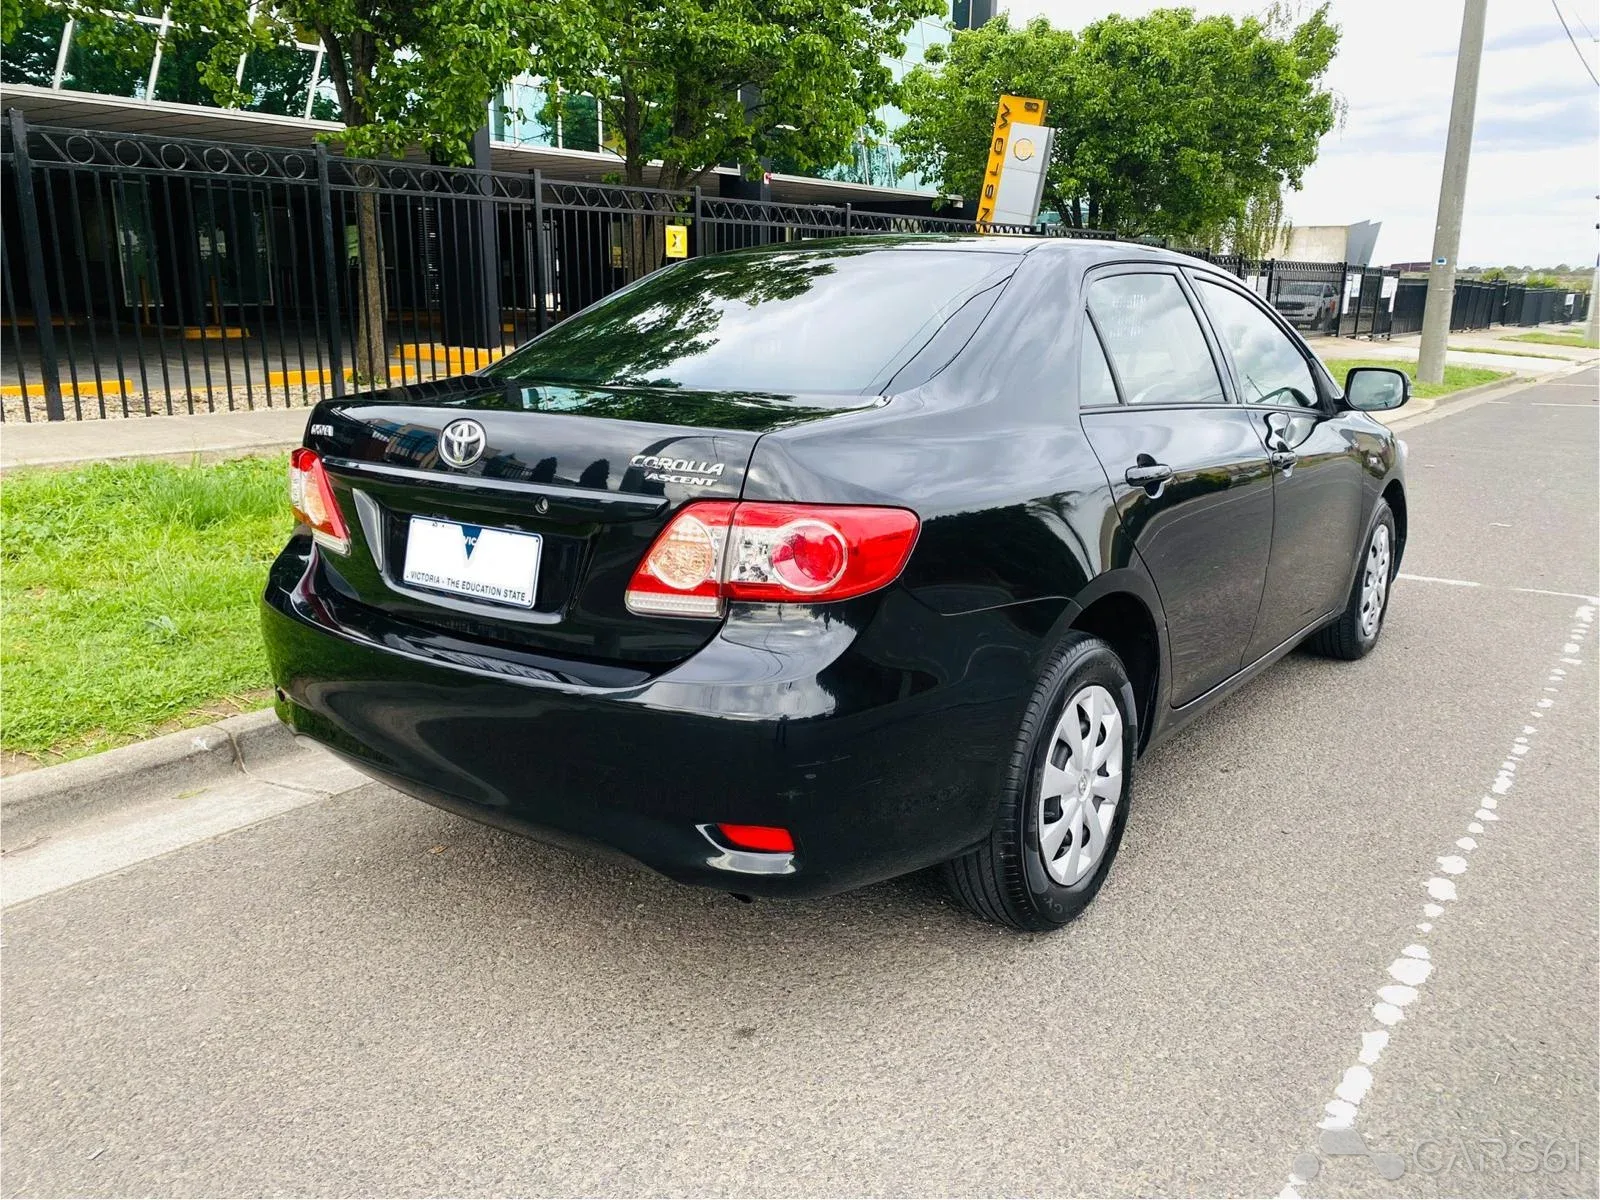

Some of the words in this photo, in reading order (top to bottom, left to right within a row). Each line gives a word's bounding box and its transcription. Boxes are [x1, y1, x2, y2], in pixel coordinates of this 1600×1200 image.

[629, 455, 725, 475] COROLLA
[644, 472, 718, 486] ASCENT
[464, 536, 477, 546] VIC
[410, 571, 440, 584] VICTORIA
[446, 577, 460, 588] THE
[461, 580, 501, 597] EDUCATION
[503, 588, 525, 602] STATE
